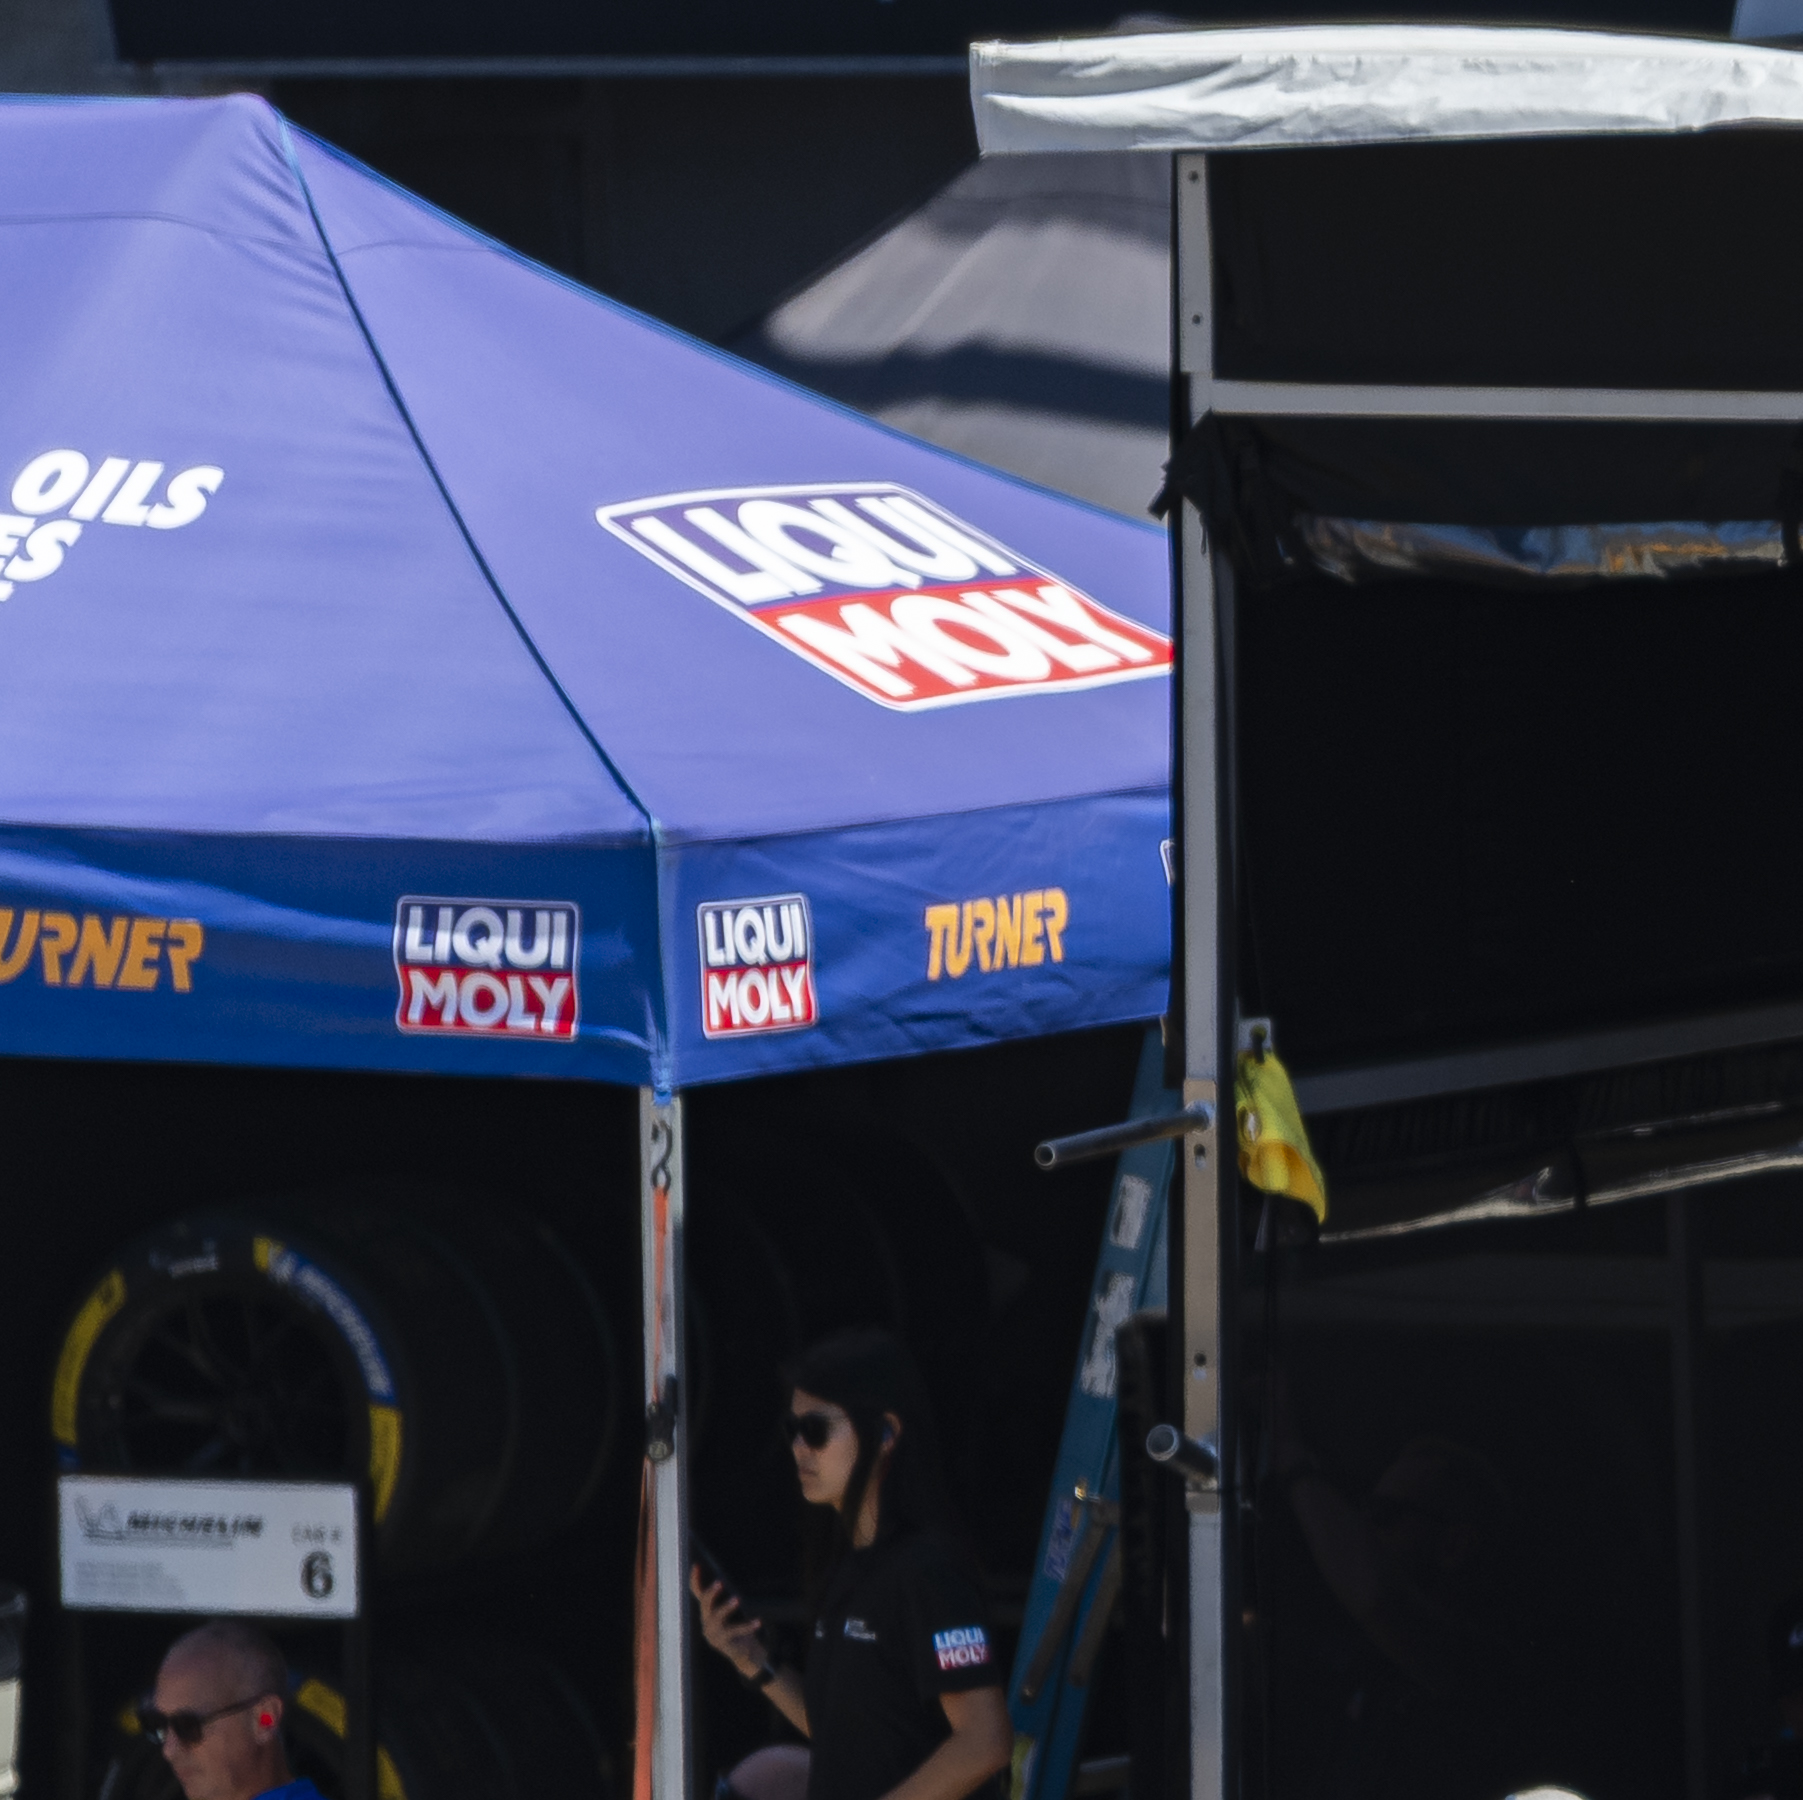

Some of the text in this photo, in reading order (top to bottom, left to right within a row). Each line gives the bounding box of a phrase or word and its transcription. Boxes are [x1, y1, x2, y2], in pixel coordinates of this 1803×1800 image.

[11, 449, 225, 529] OILS
[630, 490, 1017, 605] LIQUI
[777, 585, 1175, 699] MOLY
[0, 906, 204, 993] URNER
[404, 904, 571, 968] LIQUI
[704, 903, 806, 966] LIQUI
[924, 887, 1070, 982] TURNER
[406, 967, 573, 1036] MOLY
[706, 962, 810, 1032] MOLY
[300, 1550, 335, 1601] 6
[934, 1626, 985, 1650] LIQUI
[936, 1645, 988, 1671] MOLY
